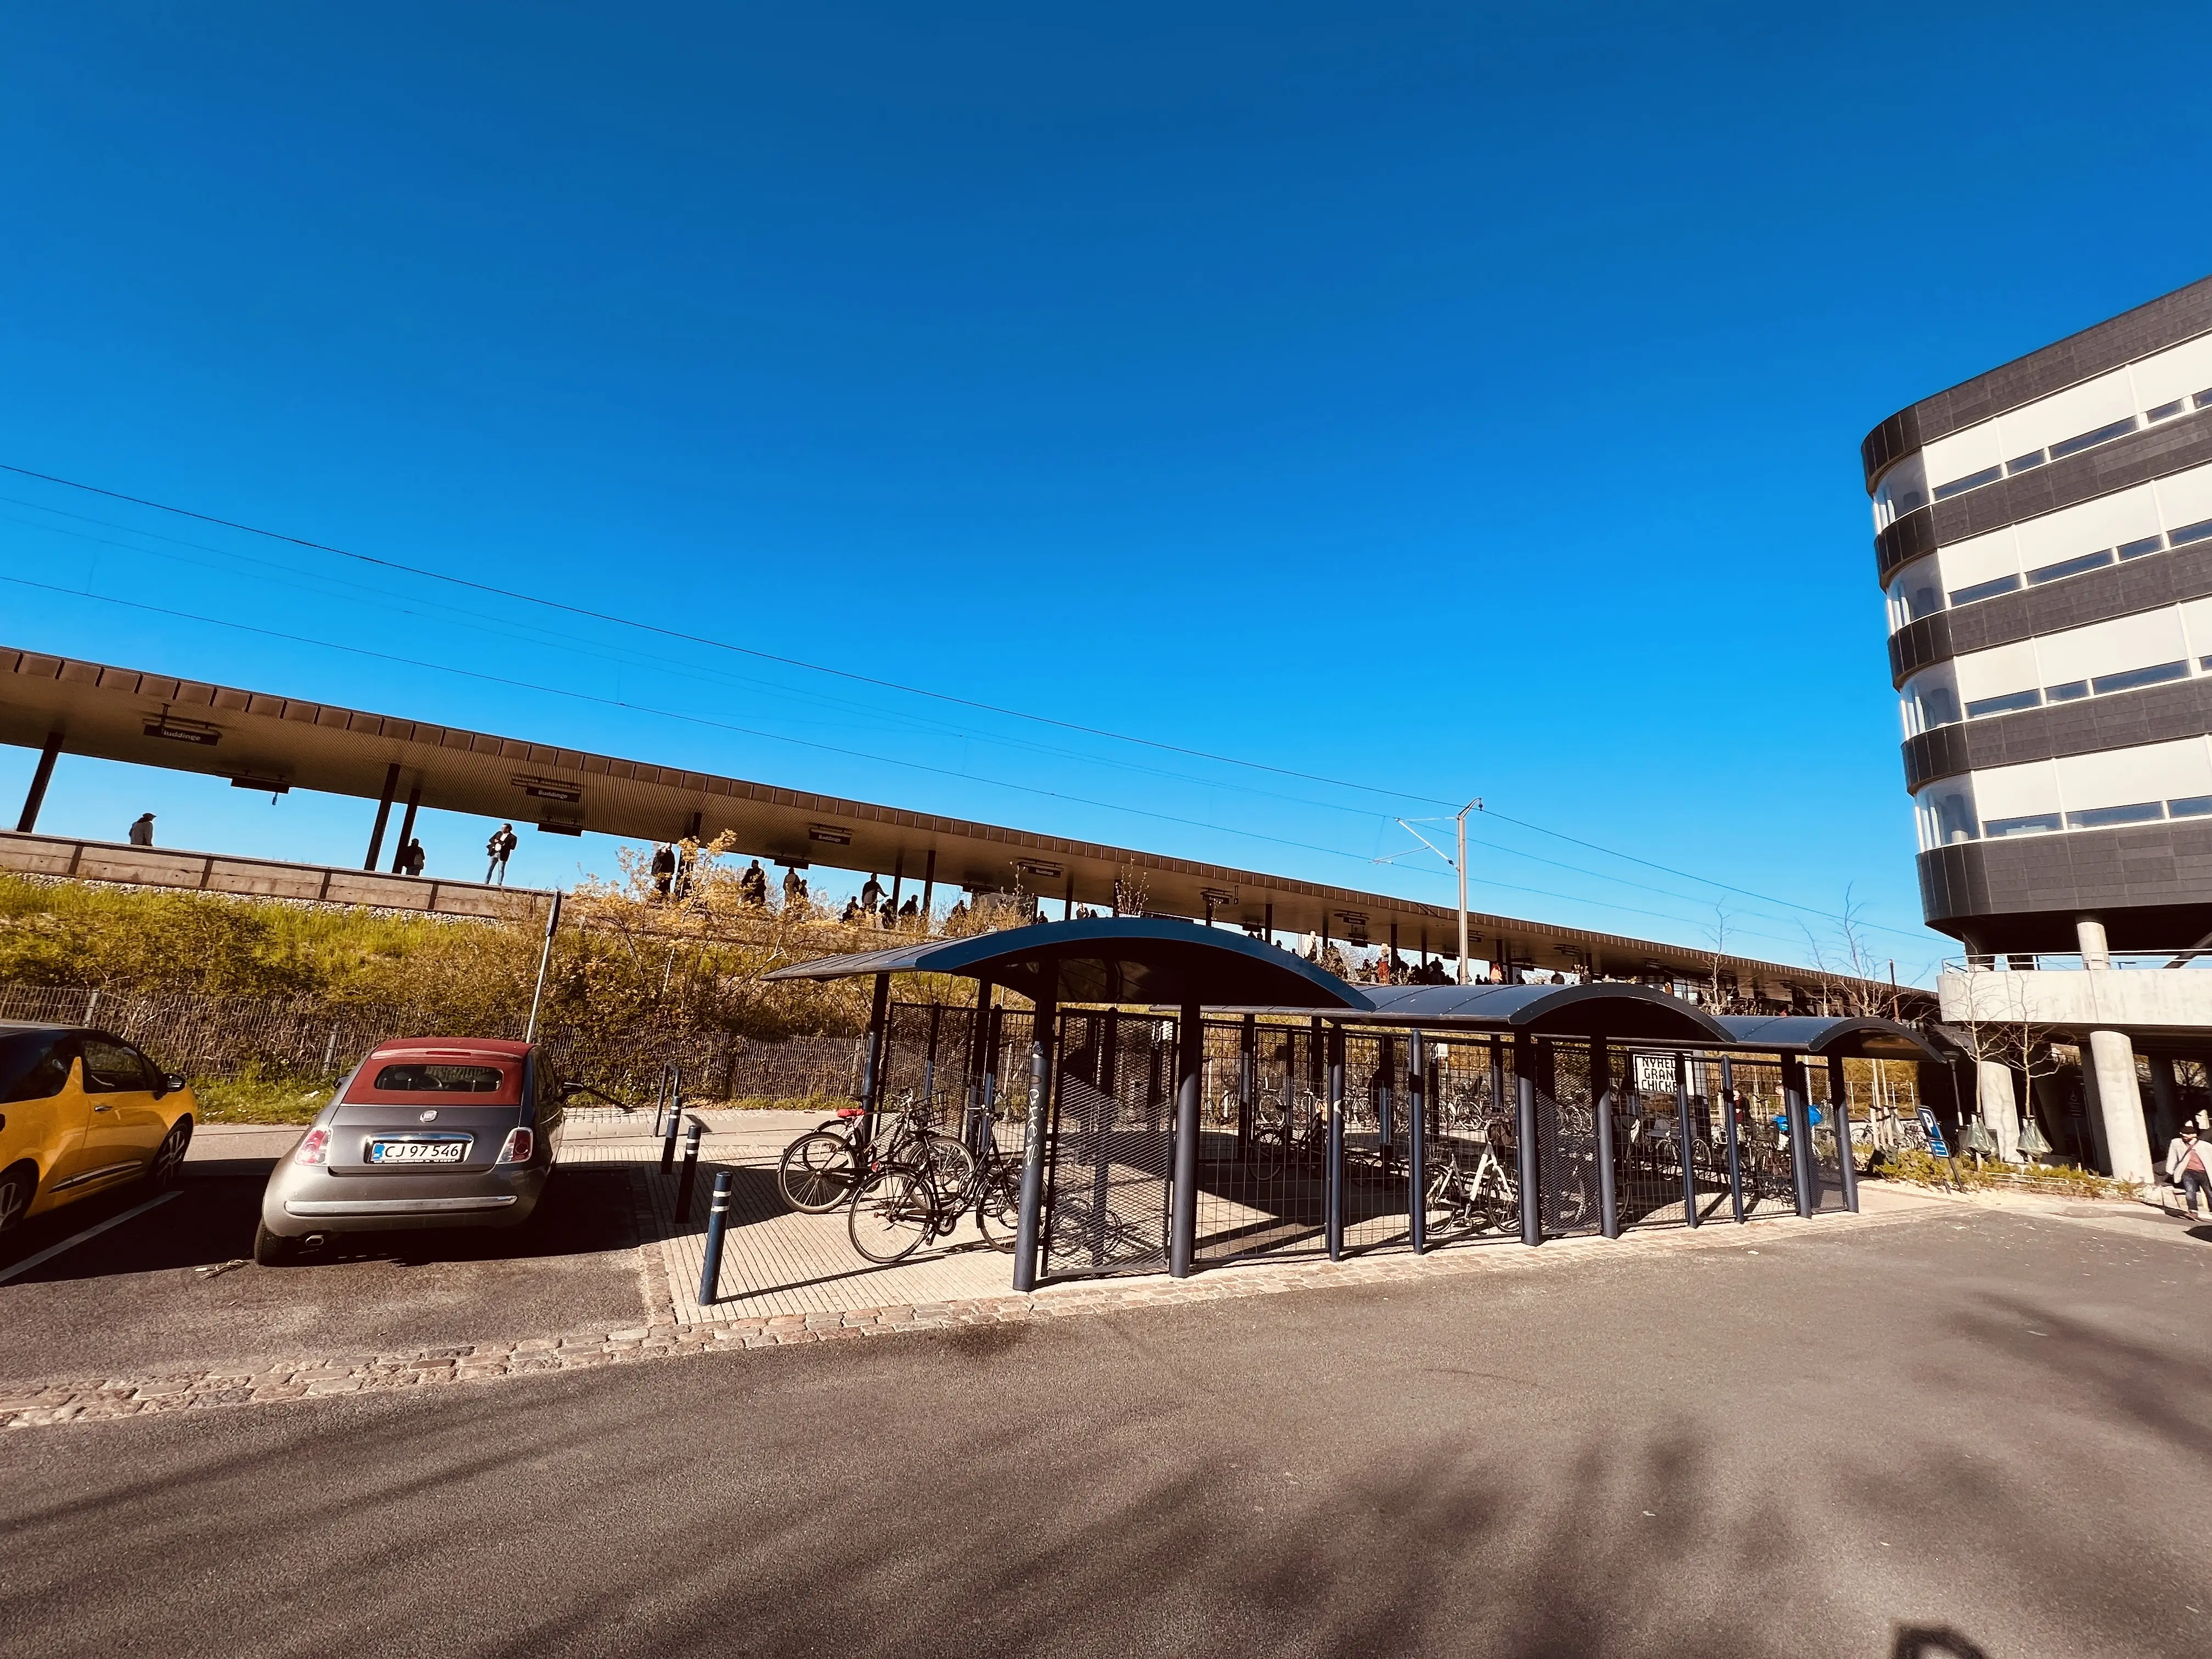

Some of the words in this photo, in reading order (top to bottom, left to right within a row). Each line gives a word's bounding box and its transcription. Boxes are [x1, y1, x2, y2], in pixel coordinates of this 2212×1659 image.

[1644, 1068, 1676, 1080] GRAN
[1642, 1079, 1678, 1093] CHICKE
[1922, 1112, 1934, 1135] P
[385, 1146, 405, 1157] CJ
[410, 1146, 428, 1157] 97
[431, 1145, 459, 1156] 546
